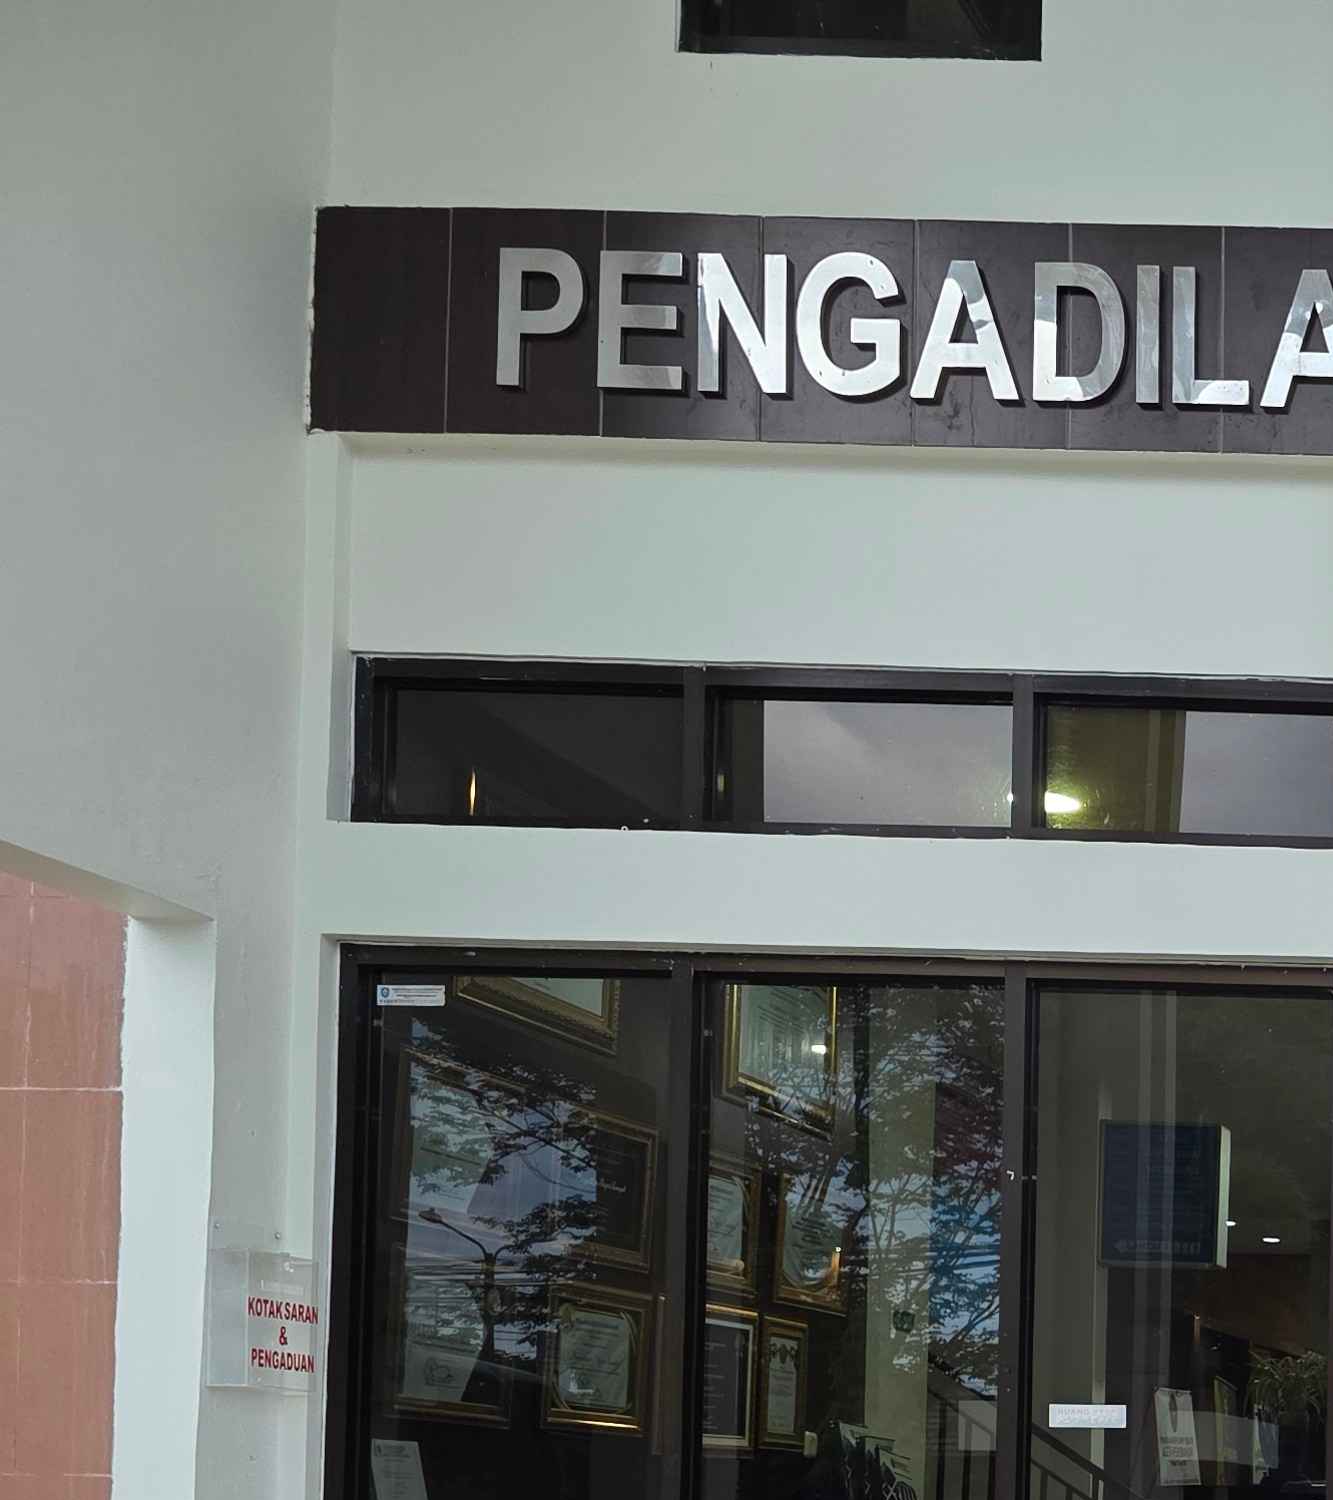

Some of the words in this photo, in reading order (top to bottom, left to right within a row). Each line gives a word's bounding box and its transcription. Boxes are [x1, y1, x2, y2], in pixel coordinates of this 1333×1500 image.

[248, 1296, 283, 1318] KOTAK
[284, 1303, 319, 1325] SARAN
[278, 1326, 288, 1346] &
[251, 1348, 315, 1374] PENGADUAN
